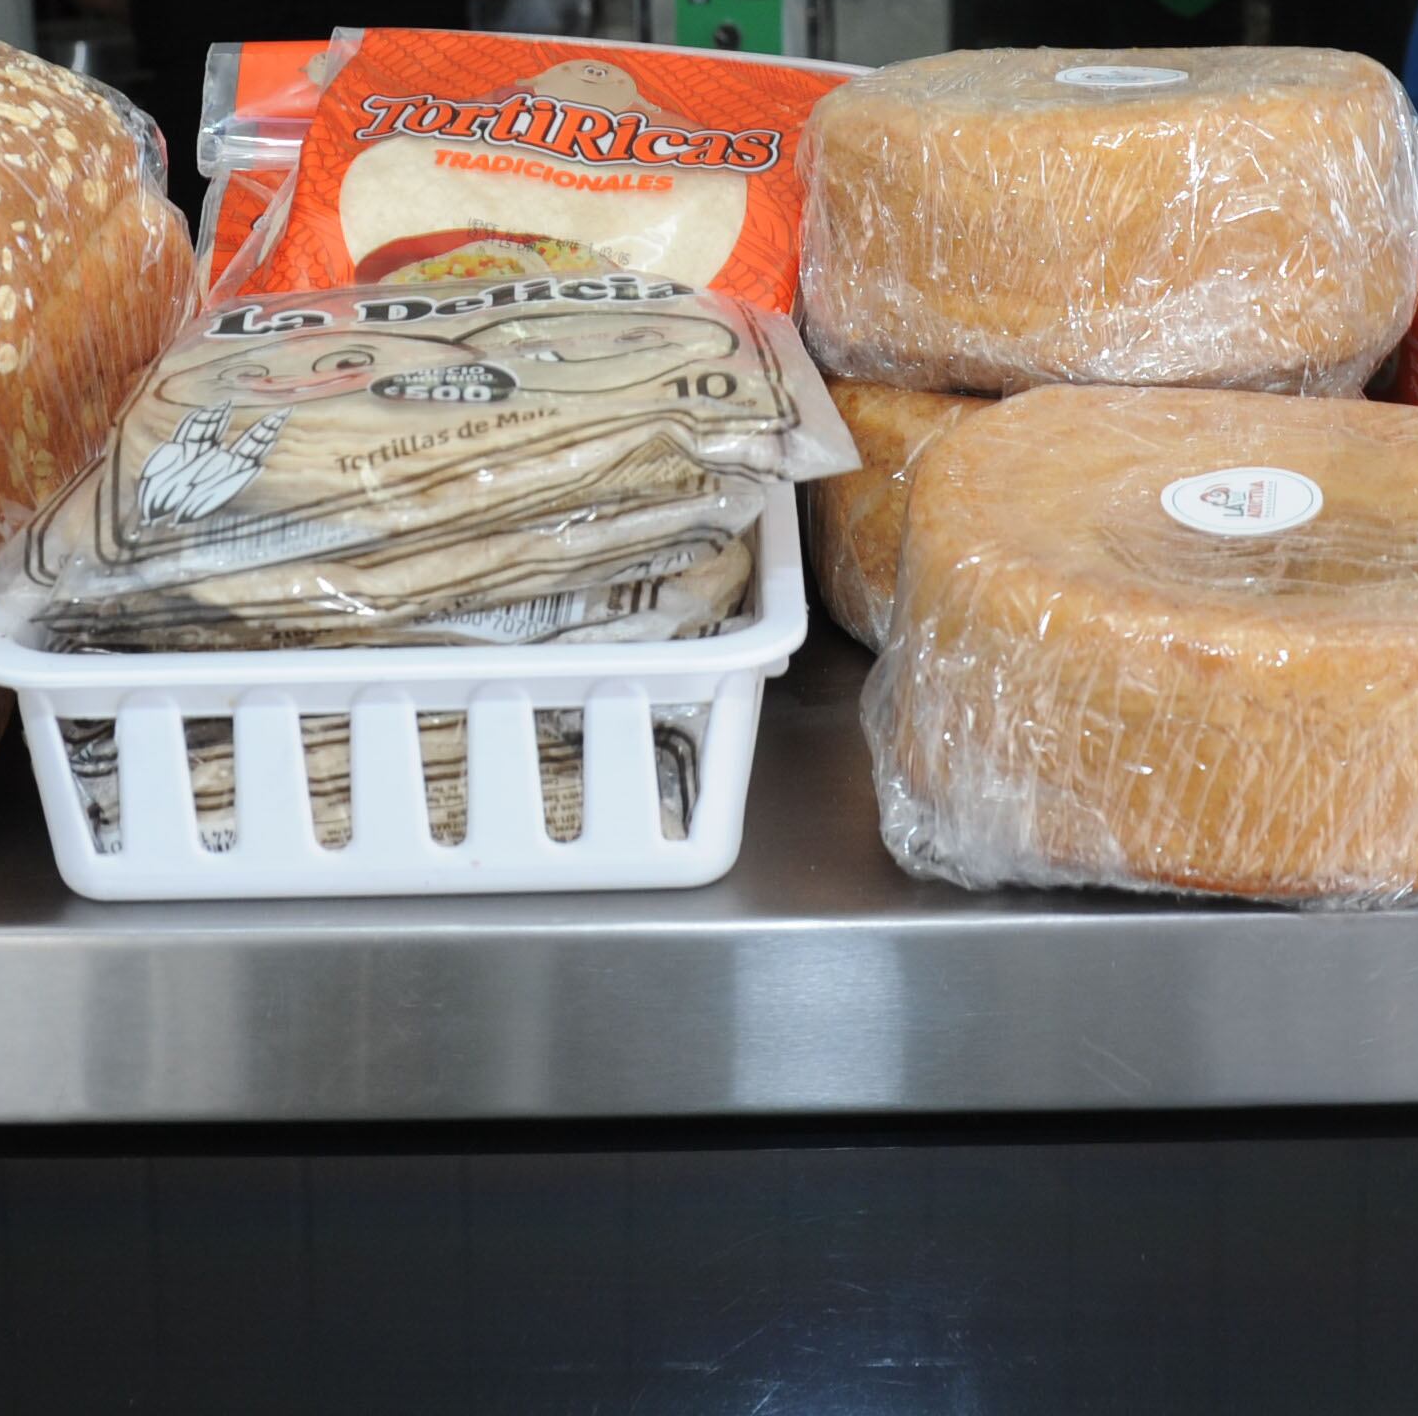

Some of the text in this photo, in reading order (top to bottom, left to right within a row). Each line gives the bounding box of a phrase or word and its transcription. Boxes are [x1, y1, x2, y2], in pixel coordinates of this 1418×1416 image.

[355, 94, 779, 169] TortiRicas
[434, 149, 674, 193] TRADICIONALES
[206, 276, 694, 338] La Delicia
[662, 372, 738, 399] 10
[335, 428, 451, 475] Tortillas
[457, 420, 490, 441] de
